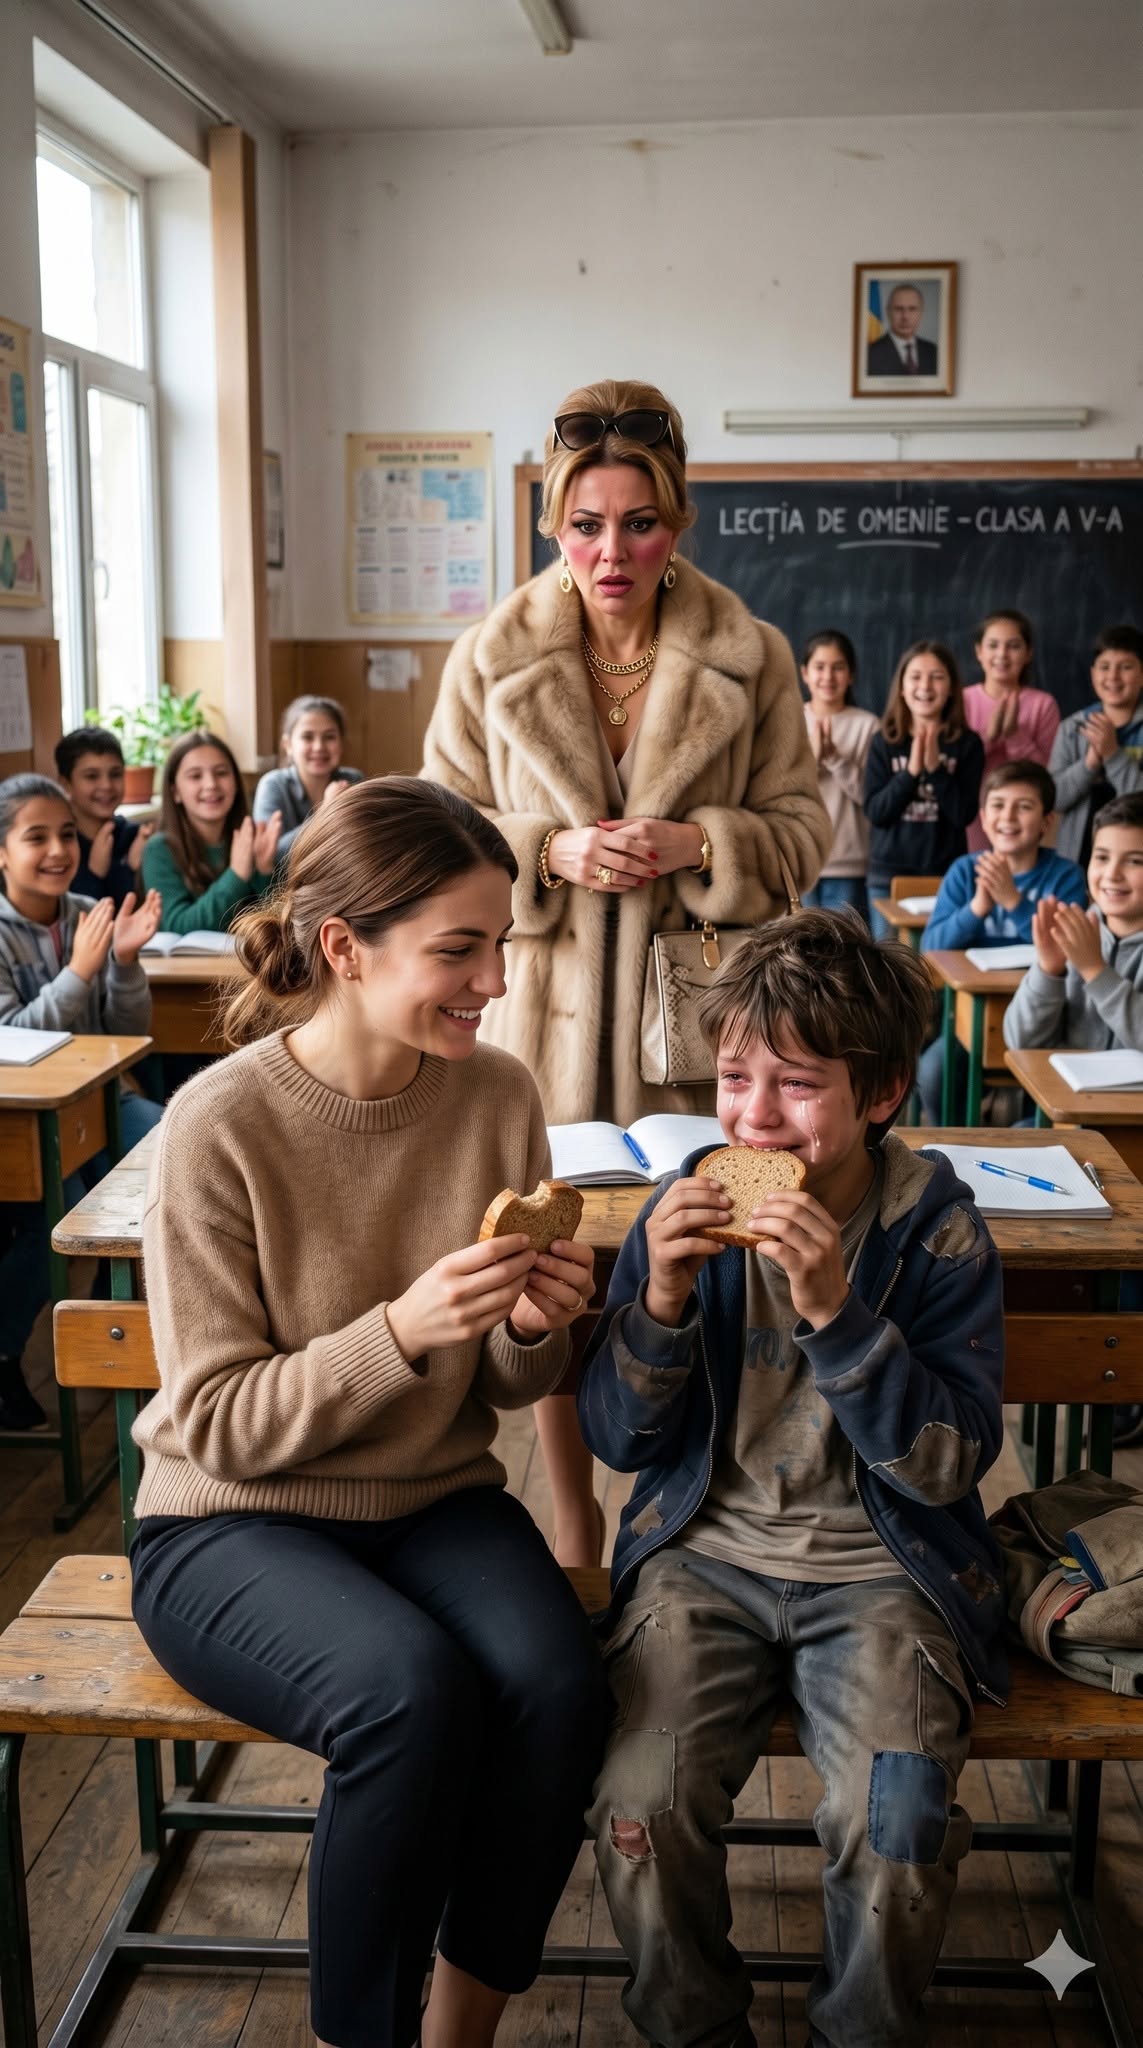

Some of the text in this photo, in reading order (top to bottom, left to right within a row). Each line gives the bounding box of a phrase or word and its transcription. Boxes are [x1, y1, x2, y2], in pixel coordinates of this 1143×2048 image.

[816, 507, 847, 534] DE
[1053, 506, 1072, 533] A
[1078, 506, 1124, 533] V-A
